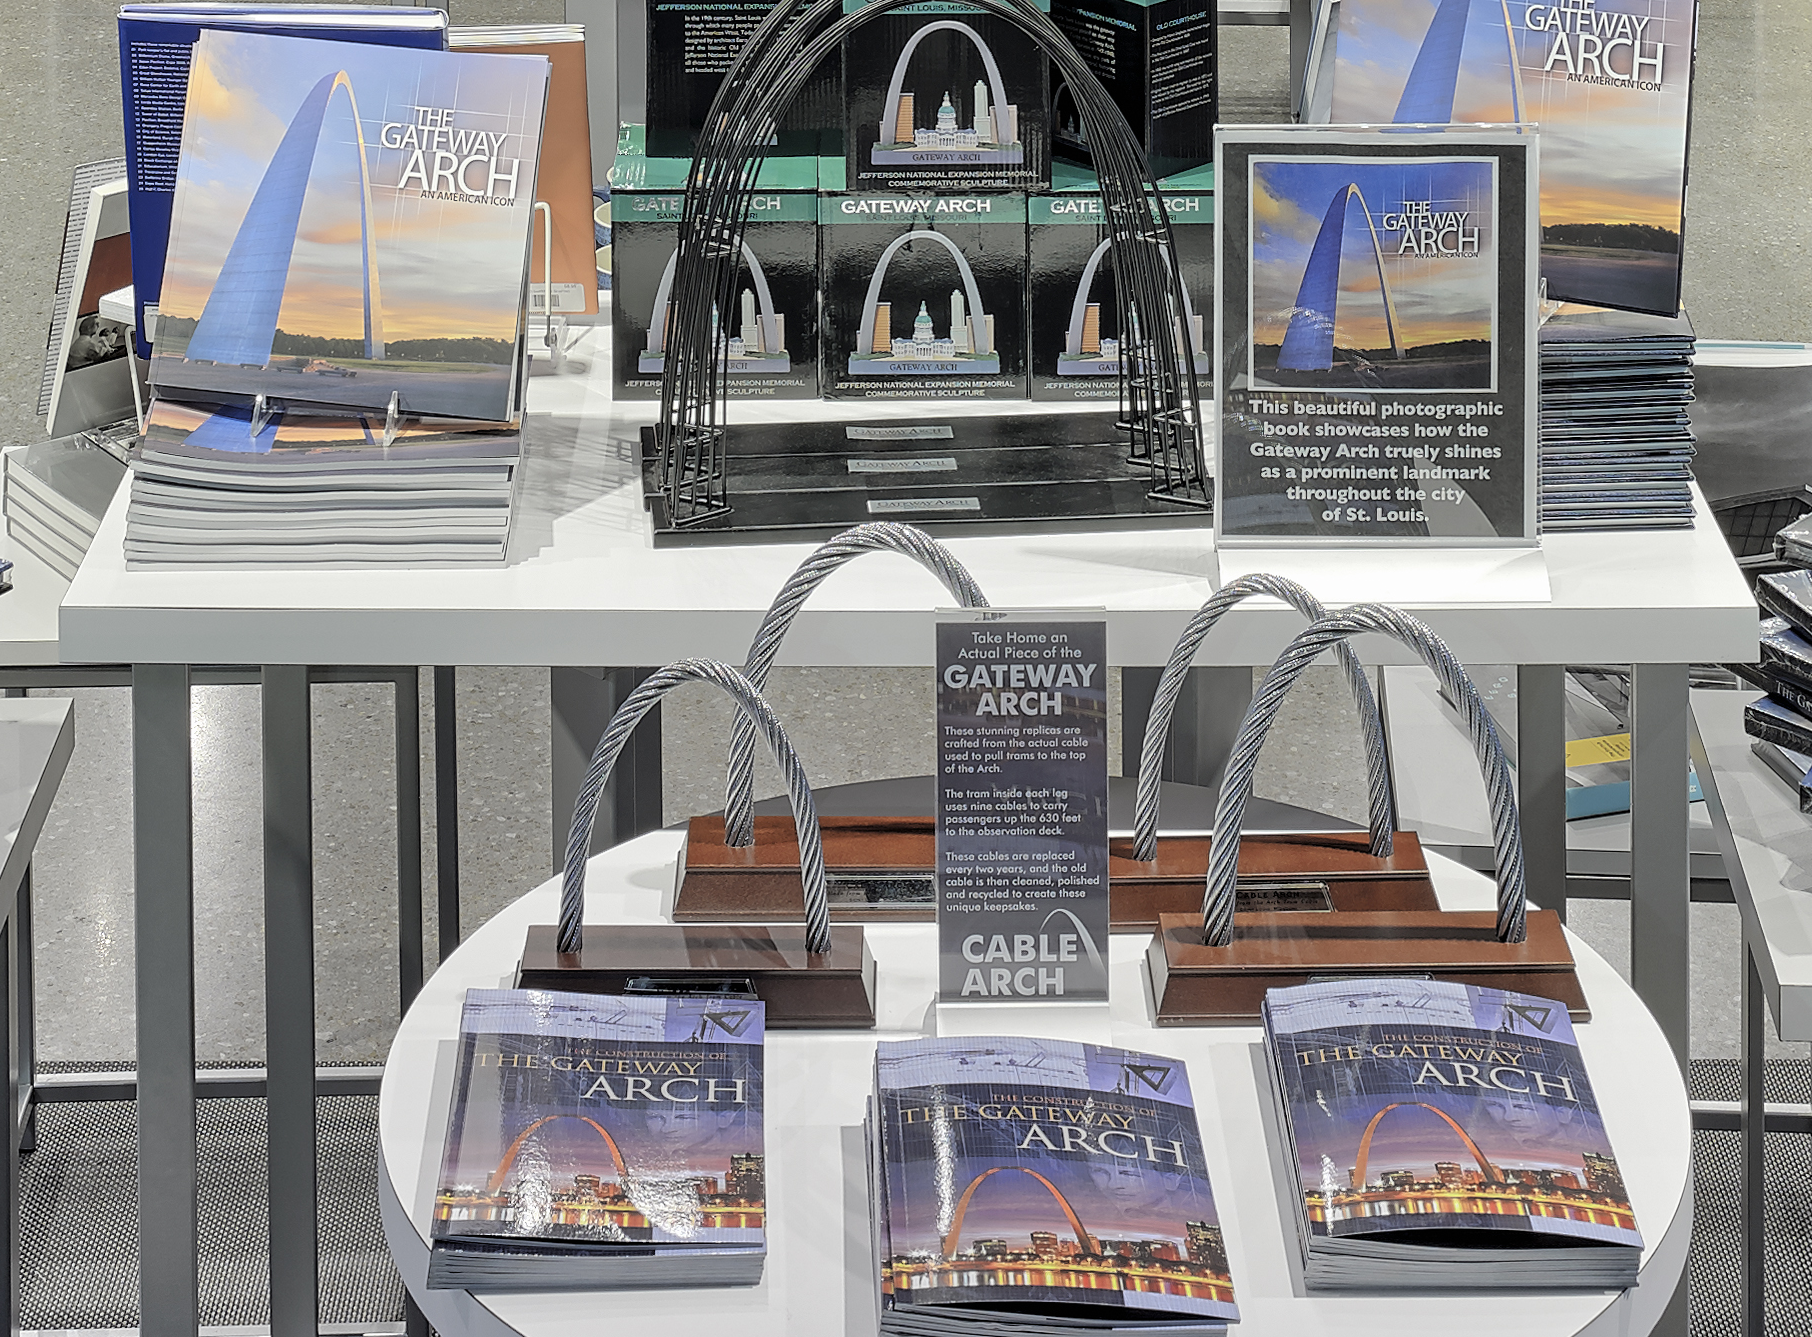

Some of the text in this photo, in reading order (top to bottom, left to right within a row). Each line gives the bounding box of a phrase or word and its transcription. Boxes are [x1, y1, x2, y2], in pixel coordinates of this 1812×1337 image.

[414, 104, 454, 129] THE
[380, 121, 507, 157] GATEWAY
[911, 152, 981, 162] GATEWAY ARCH
[396, 151, 519, 199] ARCH
[858, 170, 903, 179] JEFFERSON
[904, 170, 948, 178] NATIONAL
[949, 170, 995, 178] EXPANSION
[419, 189, 514, 207] AN AMERICAN ICON
[840, 198, 991, 214] GATEWAY ARCH
[1248, 399, 1503, 421] This beautiful photographic
[1263, 421, 1489, 438] book showcases how the
[1249, 441, 1502, 463] Gateway Arch truely shines
[1260, 462, 1491, 485] as a prominent landmark
[1286, 484, 1465, 507] throughout the city
[1321, 505, 1430, 523] of St. Louis.
[942, 663, 1098, 689] GATEWAY
[975, 690, 1062, 717] ARCH
[961, 933, 1078, 962] CABLE
[961, 967, 1064, 996] ARCH
[475, 1051, 700, 1076] THE GATEWAY
[1298, 1042, 1522, 1067] THE GATEWAY
[579, 1076, 747, 1104] ARCH
[1413, 1060, 1580, 1104] ARCH
